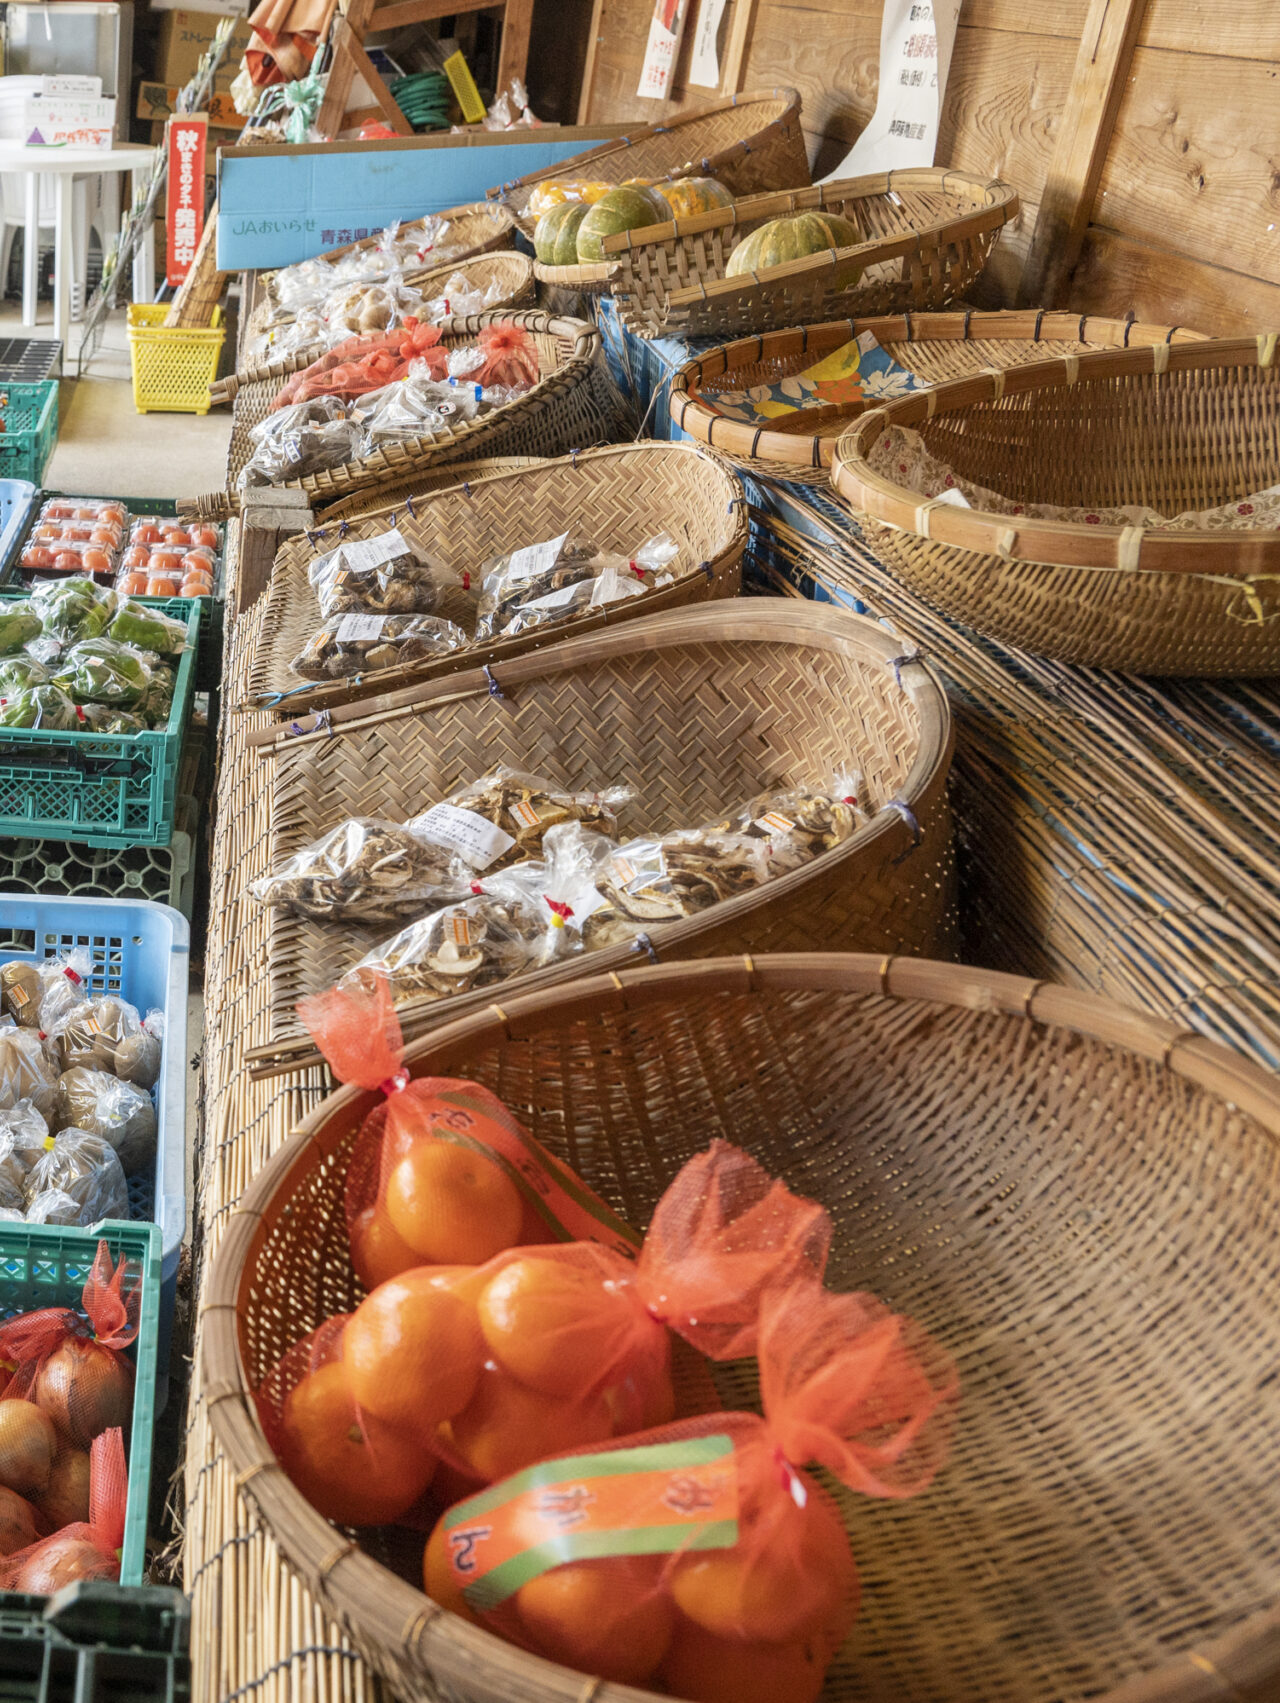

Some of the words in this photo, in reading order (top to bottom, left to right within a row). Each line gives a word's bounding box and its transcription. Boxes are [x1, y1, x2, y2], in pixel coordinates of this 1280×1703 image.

[174, 129, 199, 266] 秋まきのタネ発売中
[232, 219, 317, 235] JAおいらせ
